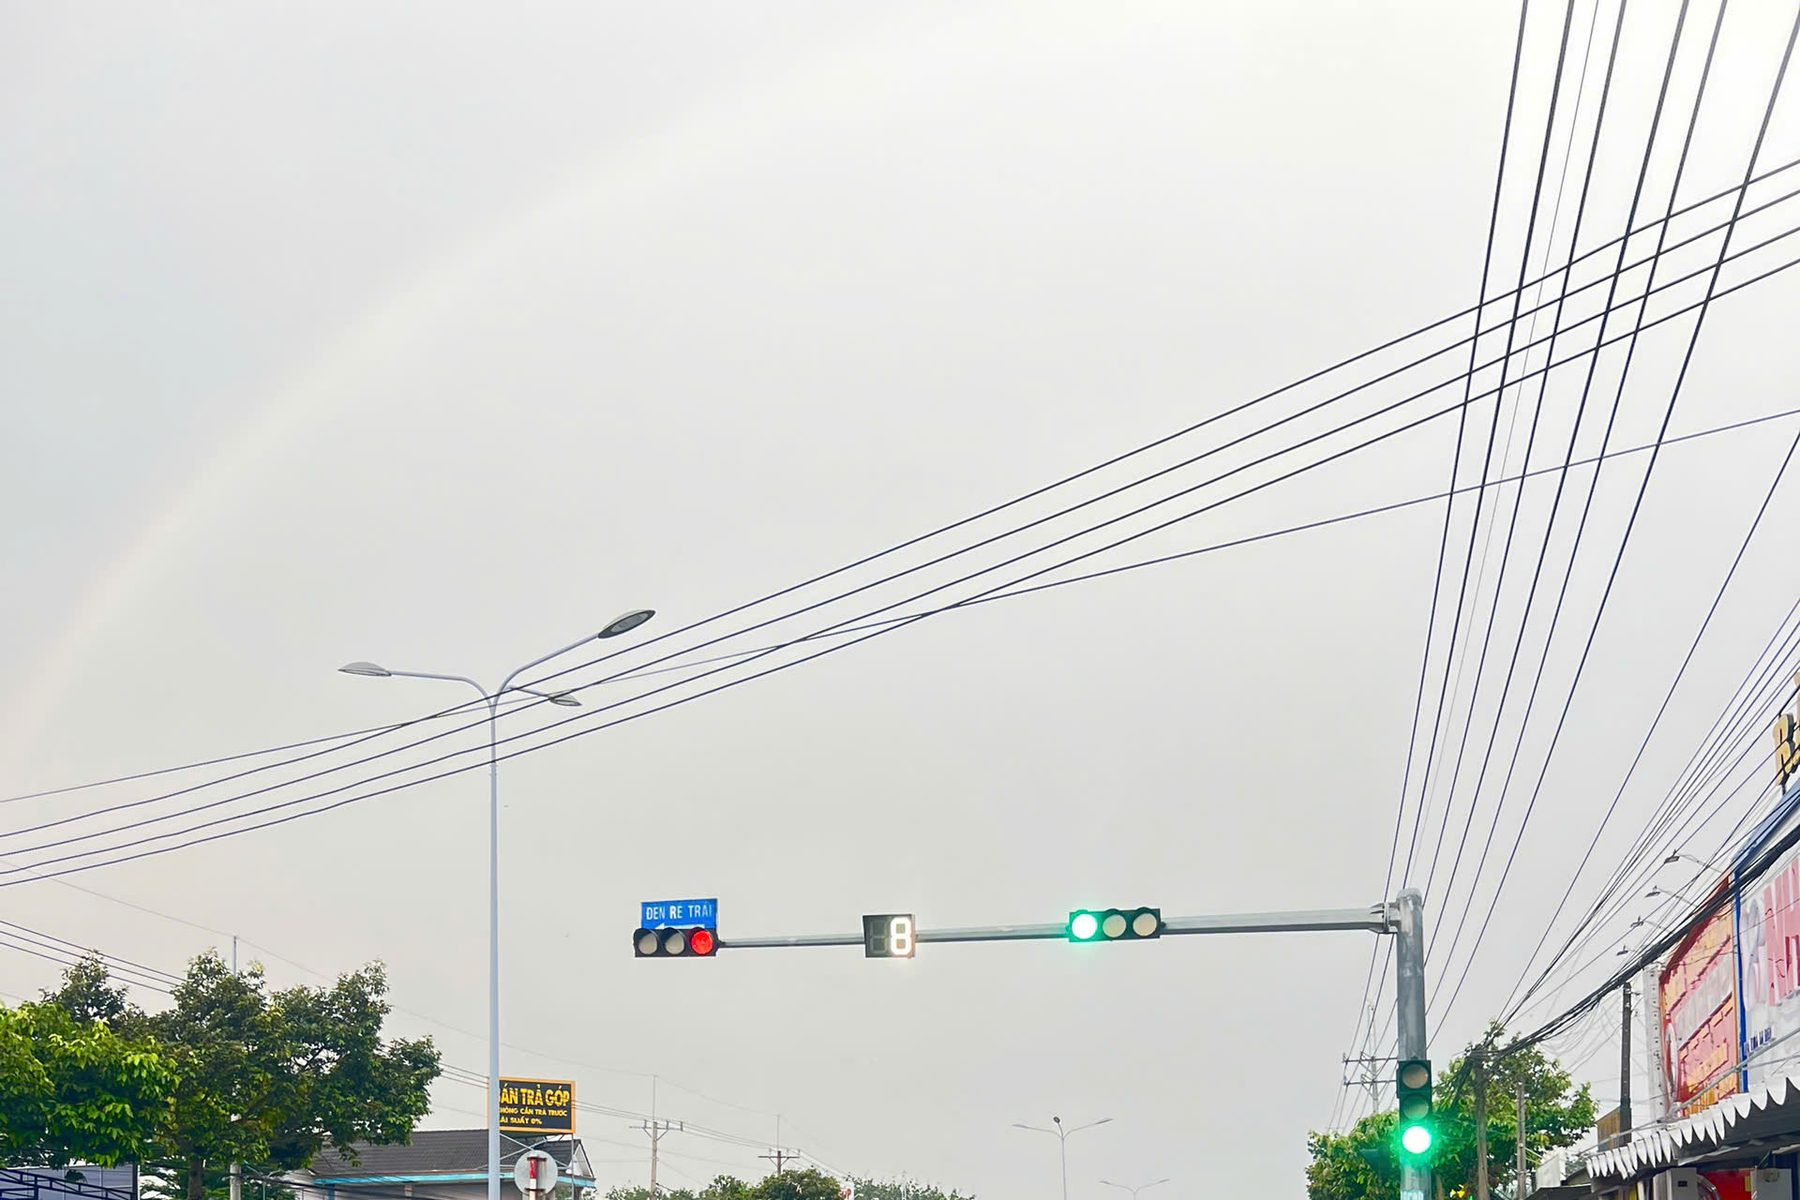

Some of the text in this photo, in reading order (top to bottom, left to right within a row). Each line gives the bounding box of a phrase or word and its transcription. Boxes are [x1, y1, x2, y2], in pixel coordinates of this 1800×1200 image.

[890, 917, 912, 956] 8
[500, 1083, 519, 1105] ÁN
[545, 1085, 570, 1107] GÓP
